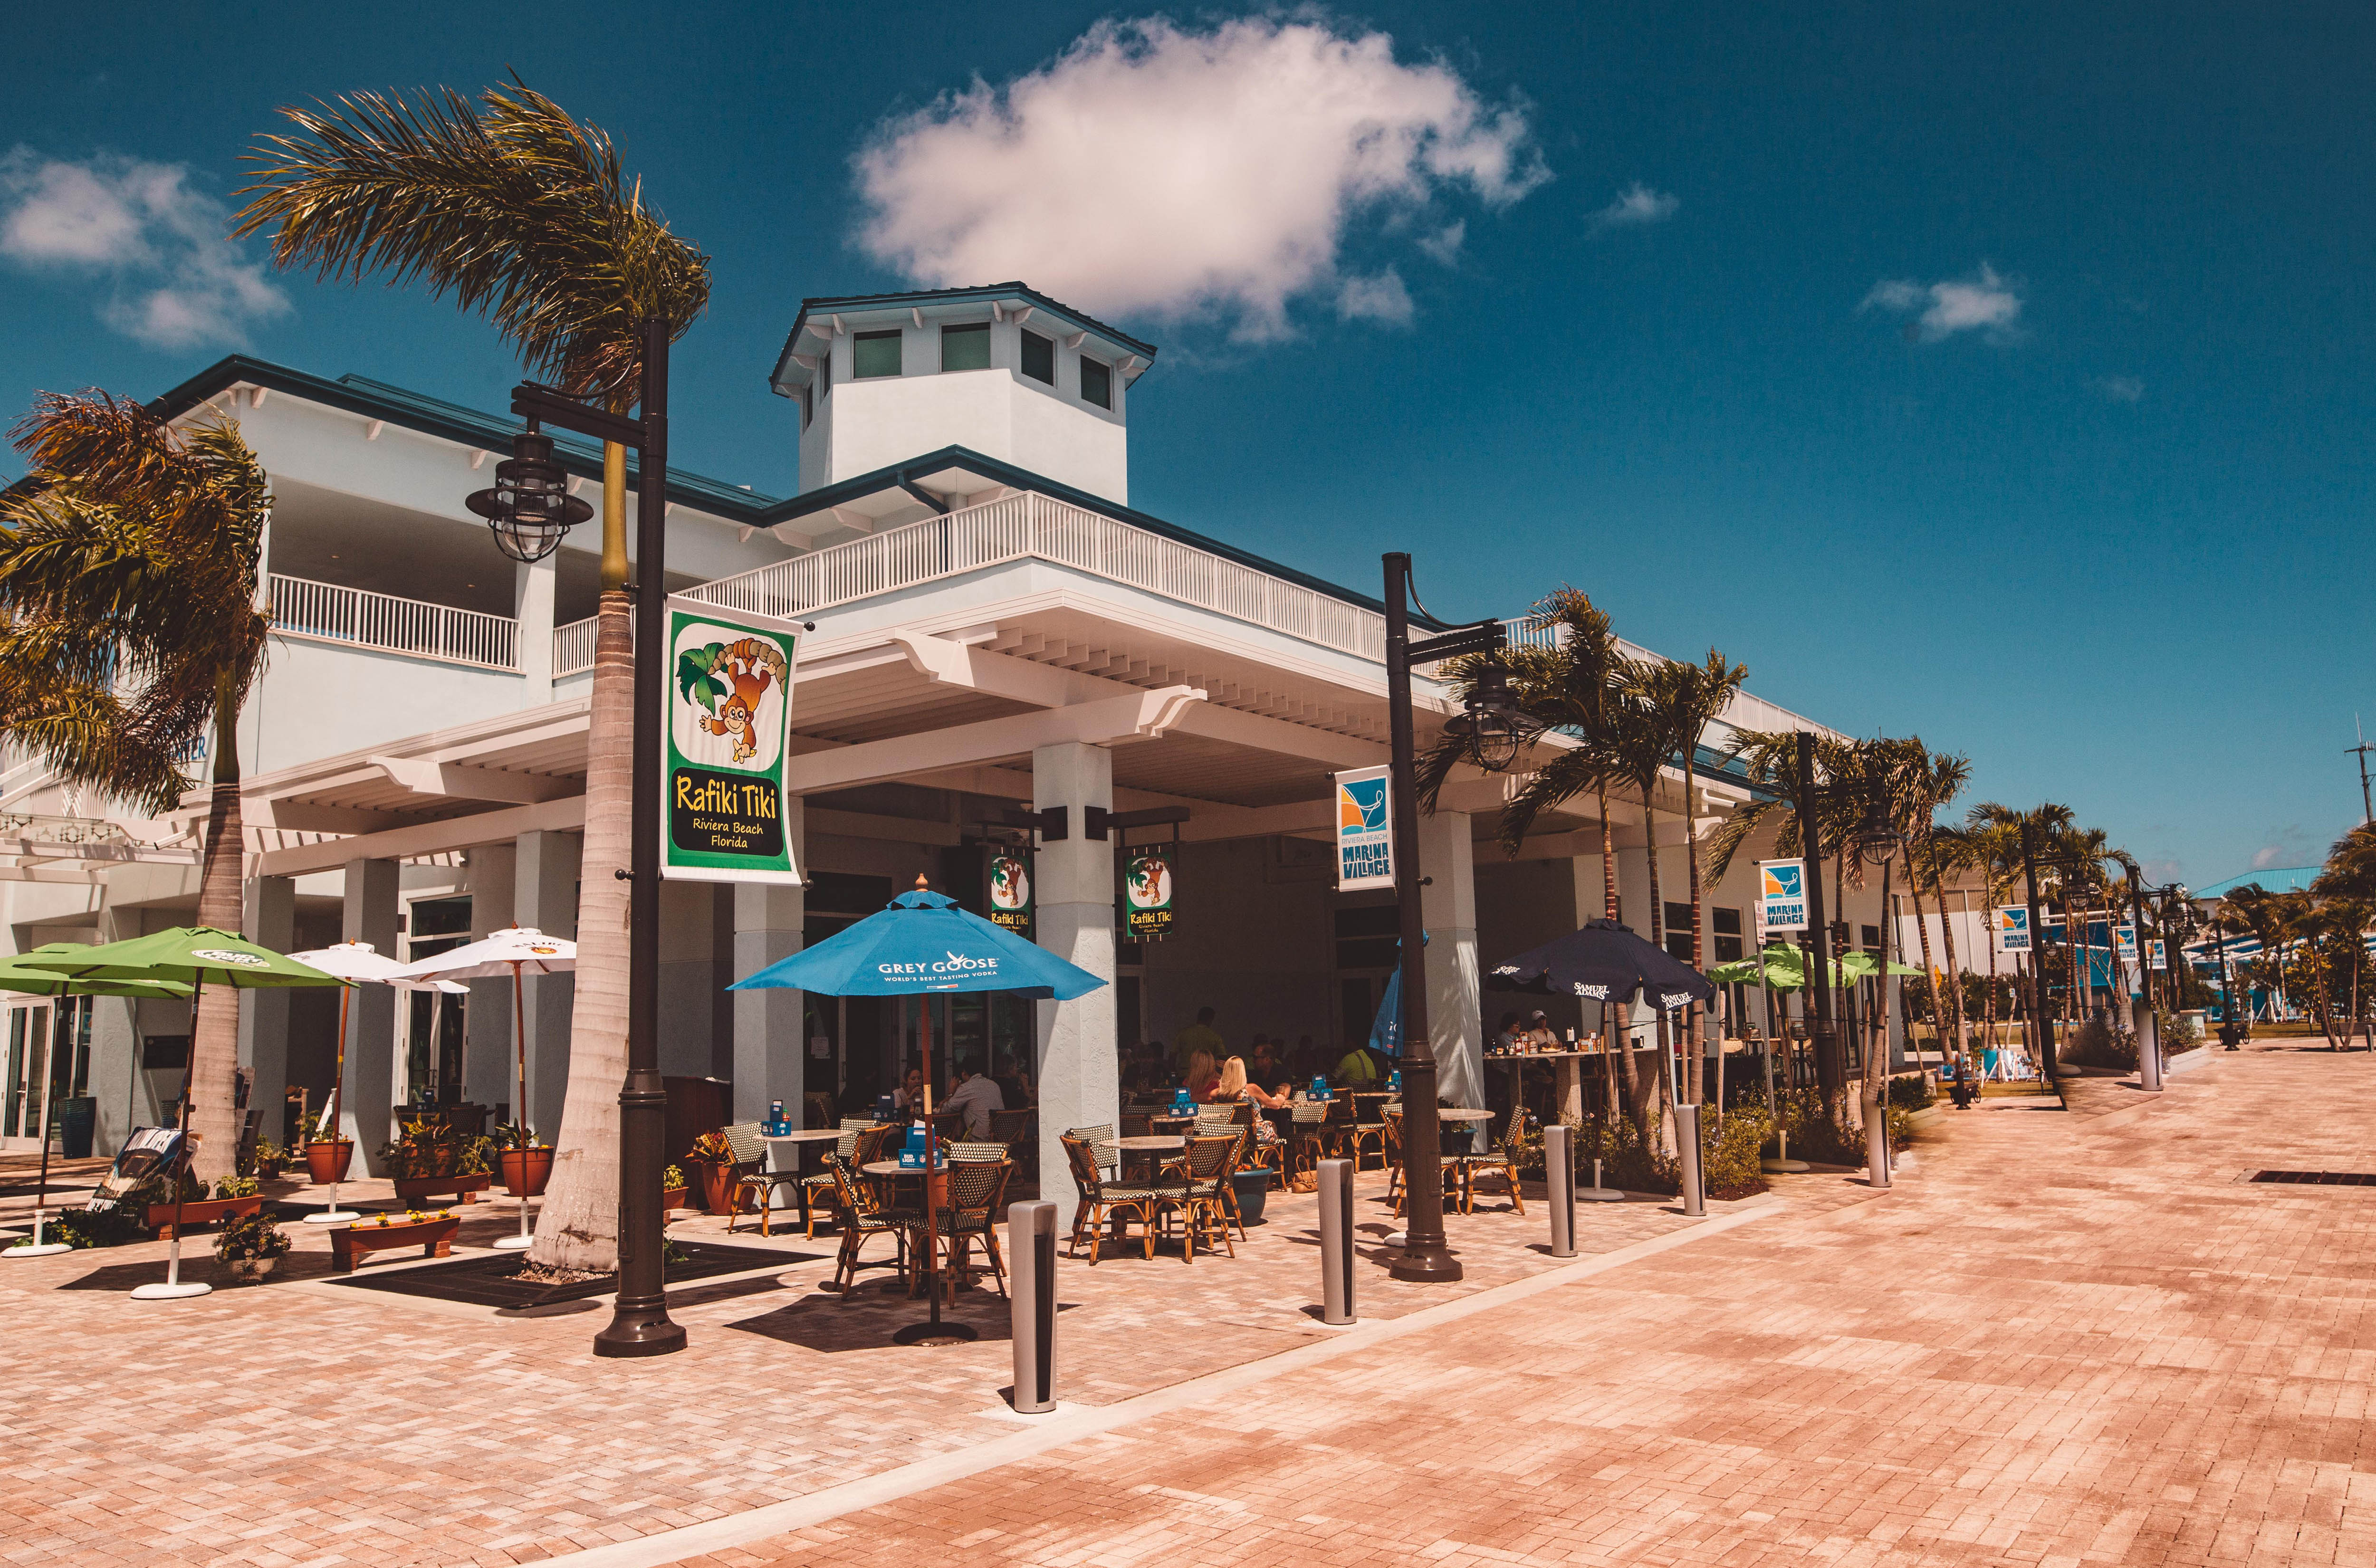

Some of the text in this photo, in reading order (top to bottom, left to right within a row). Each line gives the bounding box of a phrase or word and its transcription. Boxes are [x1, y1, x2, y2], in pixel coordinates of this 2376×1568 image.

[677, 775, 776, 819] Rafiki Tiki
[693, 818, 763, 834] Riviera Beach
[711, 834, 747, 848] Florida
[1341, 833, 1387, 844] RIVIERA BEACH
[1342, 842, 1389, 862] MARINA
[1343, 859, 1390, 879] VILLAGE
[1767, 904, 1803, 915] MARINA
[992, 913, 1028, 925] Rafiki Tiki
[1131, 911, 1172, 924] Rafiki Tiki
[1768, 914, 1804, 925] VILLAGE
[879, 955, 999, 974] GREY GOOSE
[1574, 982, 1610, 994] SAMUEL
[1575, 989, 1606, 1000] ADAMS
[1661, 992, 1693, 1003] SAMUEL
[1666, 997, 1692, 1010] ADAMS
